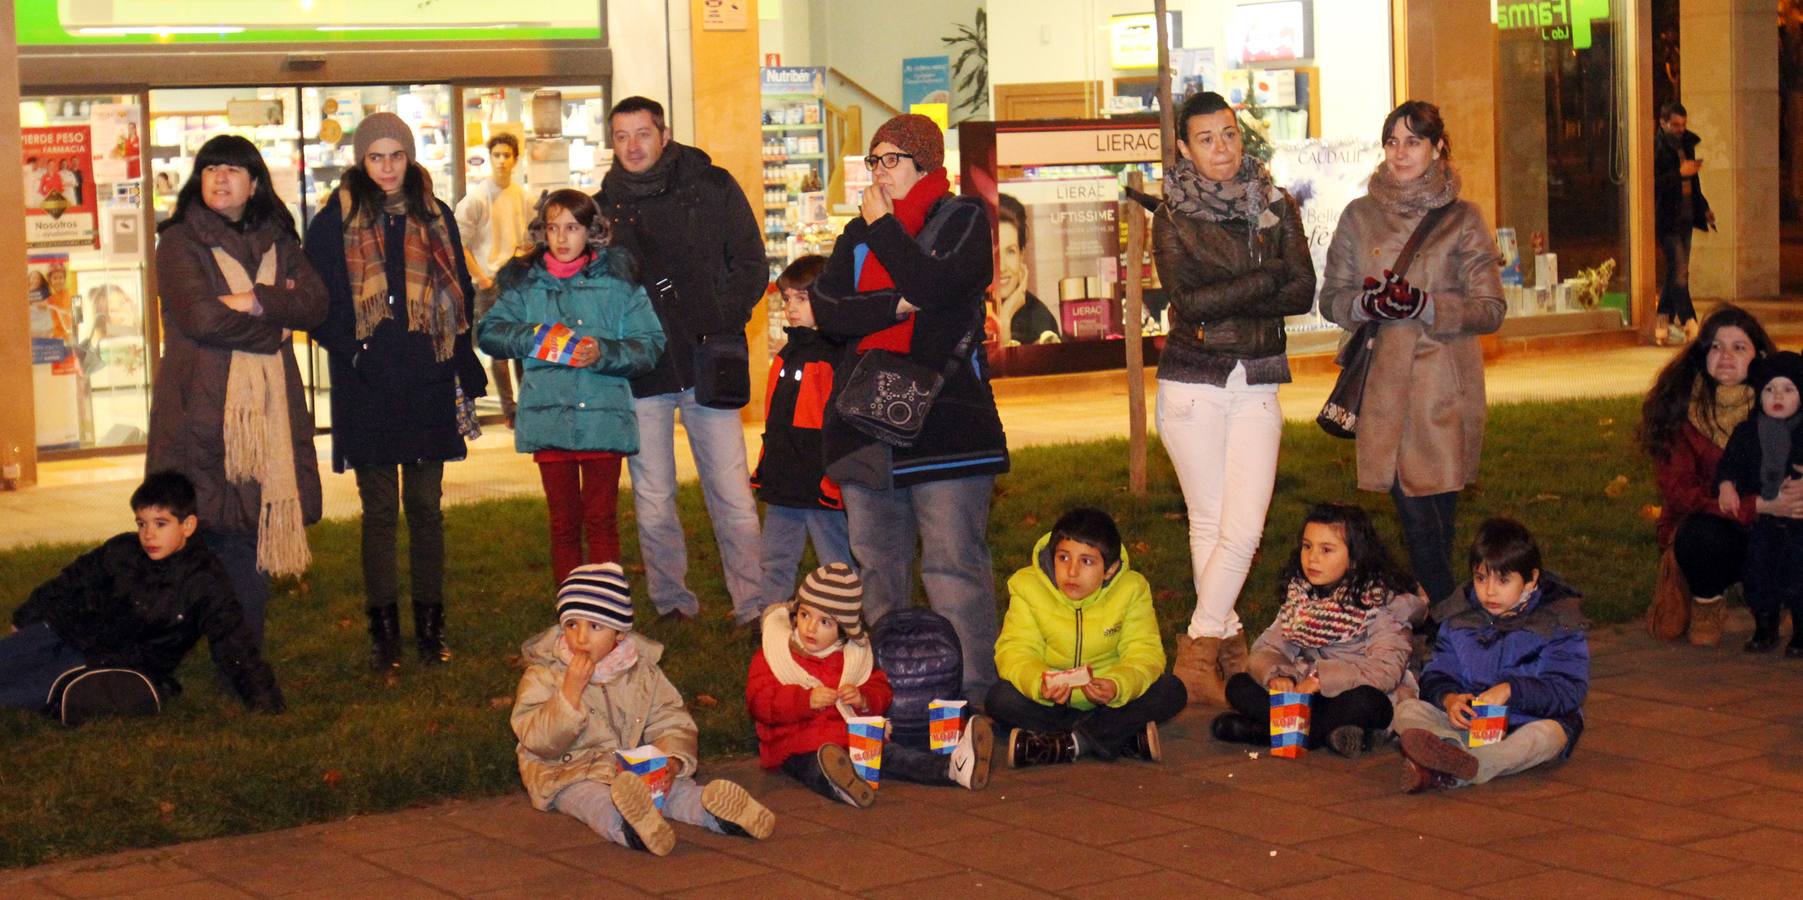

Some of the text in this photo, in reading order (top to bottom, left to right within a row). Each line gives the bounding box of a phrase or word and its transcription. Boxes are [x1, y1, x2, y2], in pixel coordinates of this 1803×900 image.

[56, 132, 84, 144] PESO
[1096, 132, 1160, 152] LIERAC
[43, 145, 85, 153] FARMACIA
[1056, 185, 1106, 199] LIERAC
[1050, 209, 1115, 223] LIFTISSIME
[35, 220, 78, 230] Nosotros
[1072, 305, 1102, 316] LIERAC
